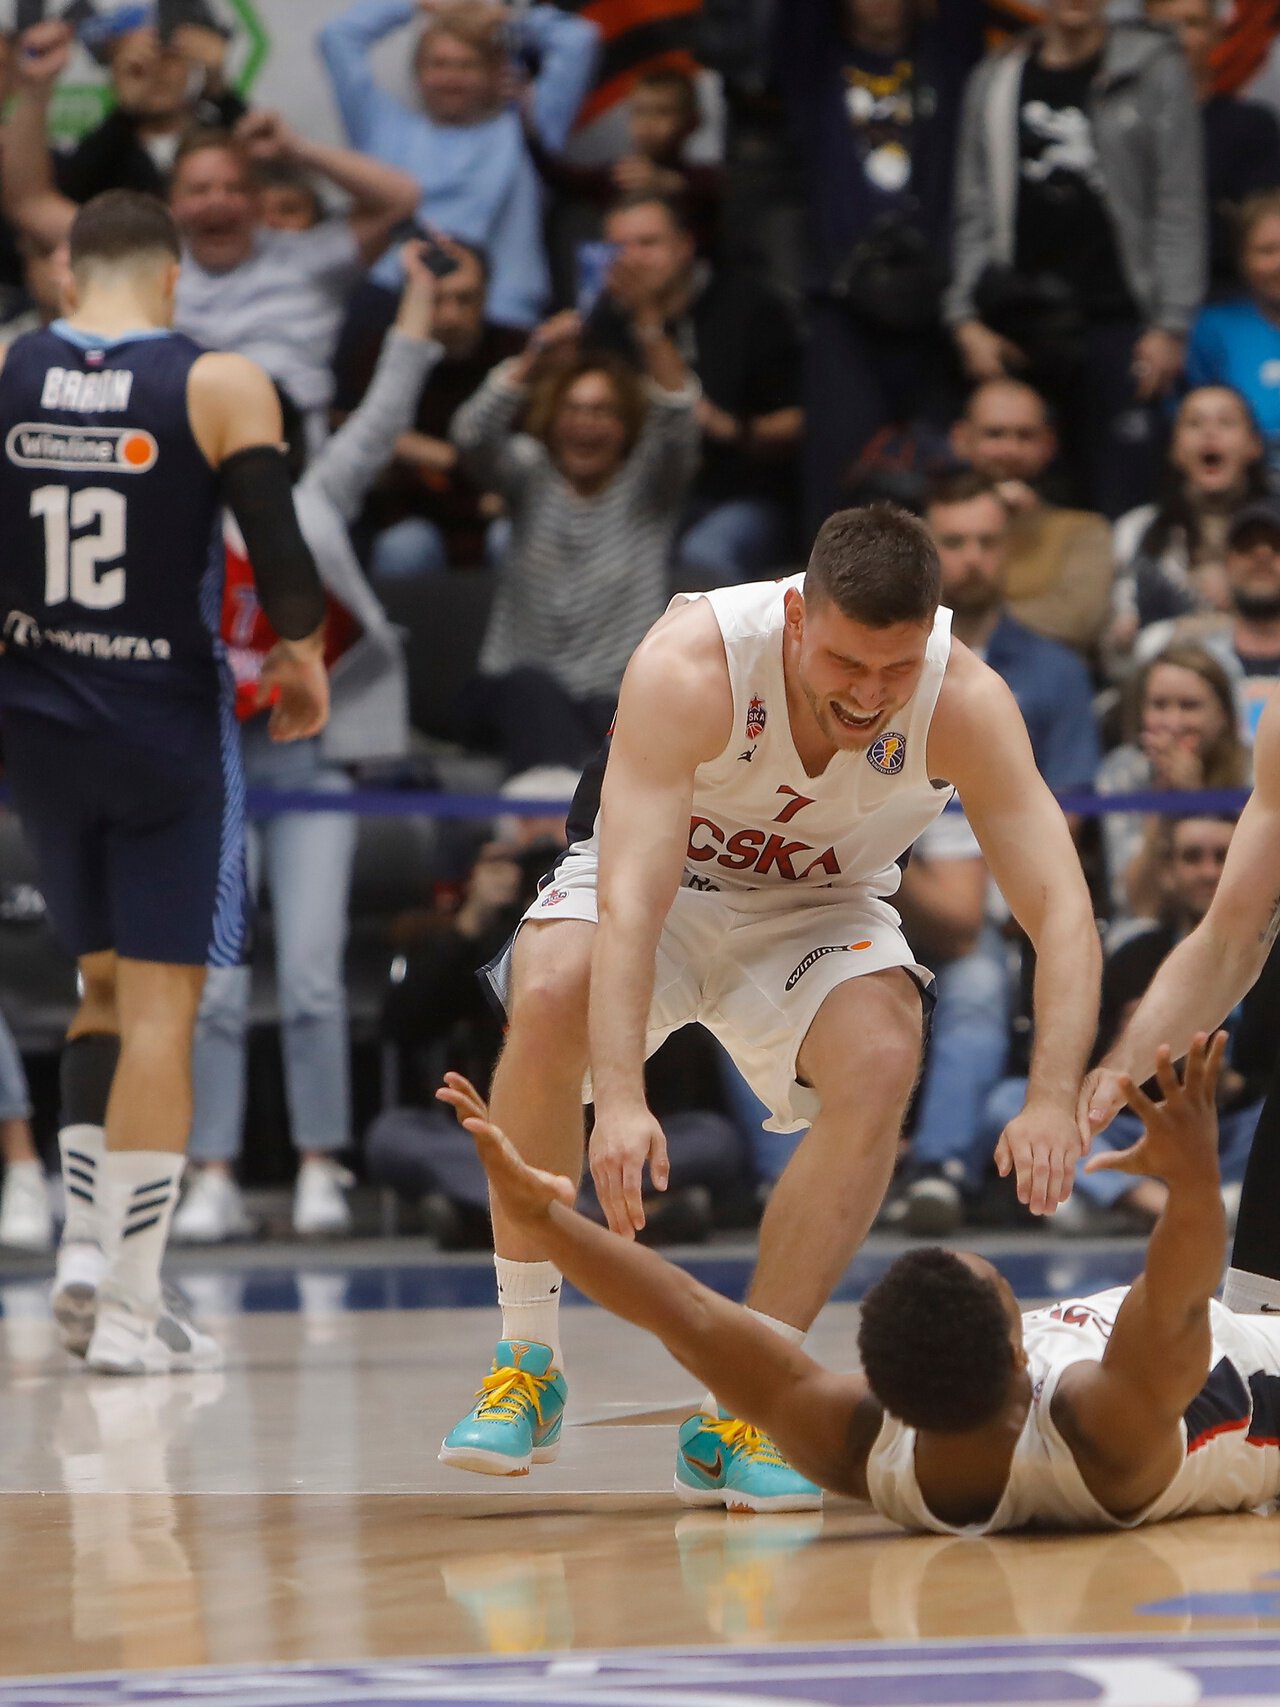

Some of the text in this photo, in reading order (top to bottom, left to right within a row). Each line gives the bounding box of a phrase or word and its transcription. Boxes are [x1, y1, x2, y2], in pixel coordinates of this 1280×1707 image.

[29, 484, 127, 610] 12
[771, 784, 817, 824] 7
[686, 815, 842, 881] CSKA
